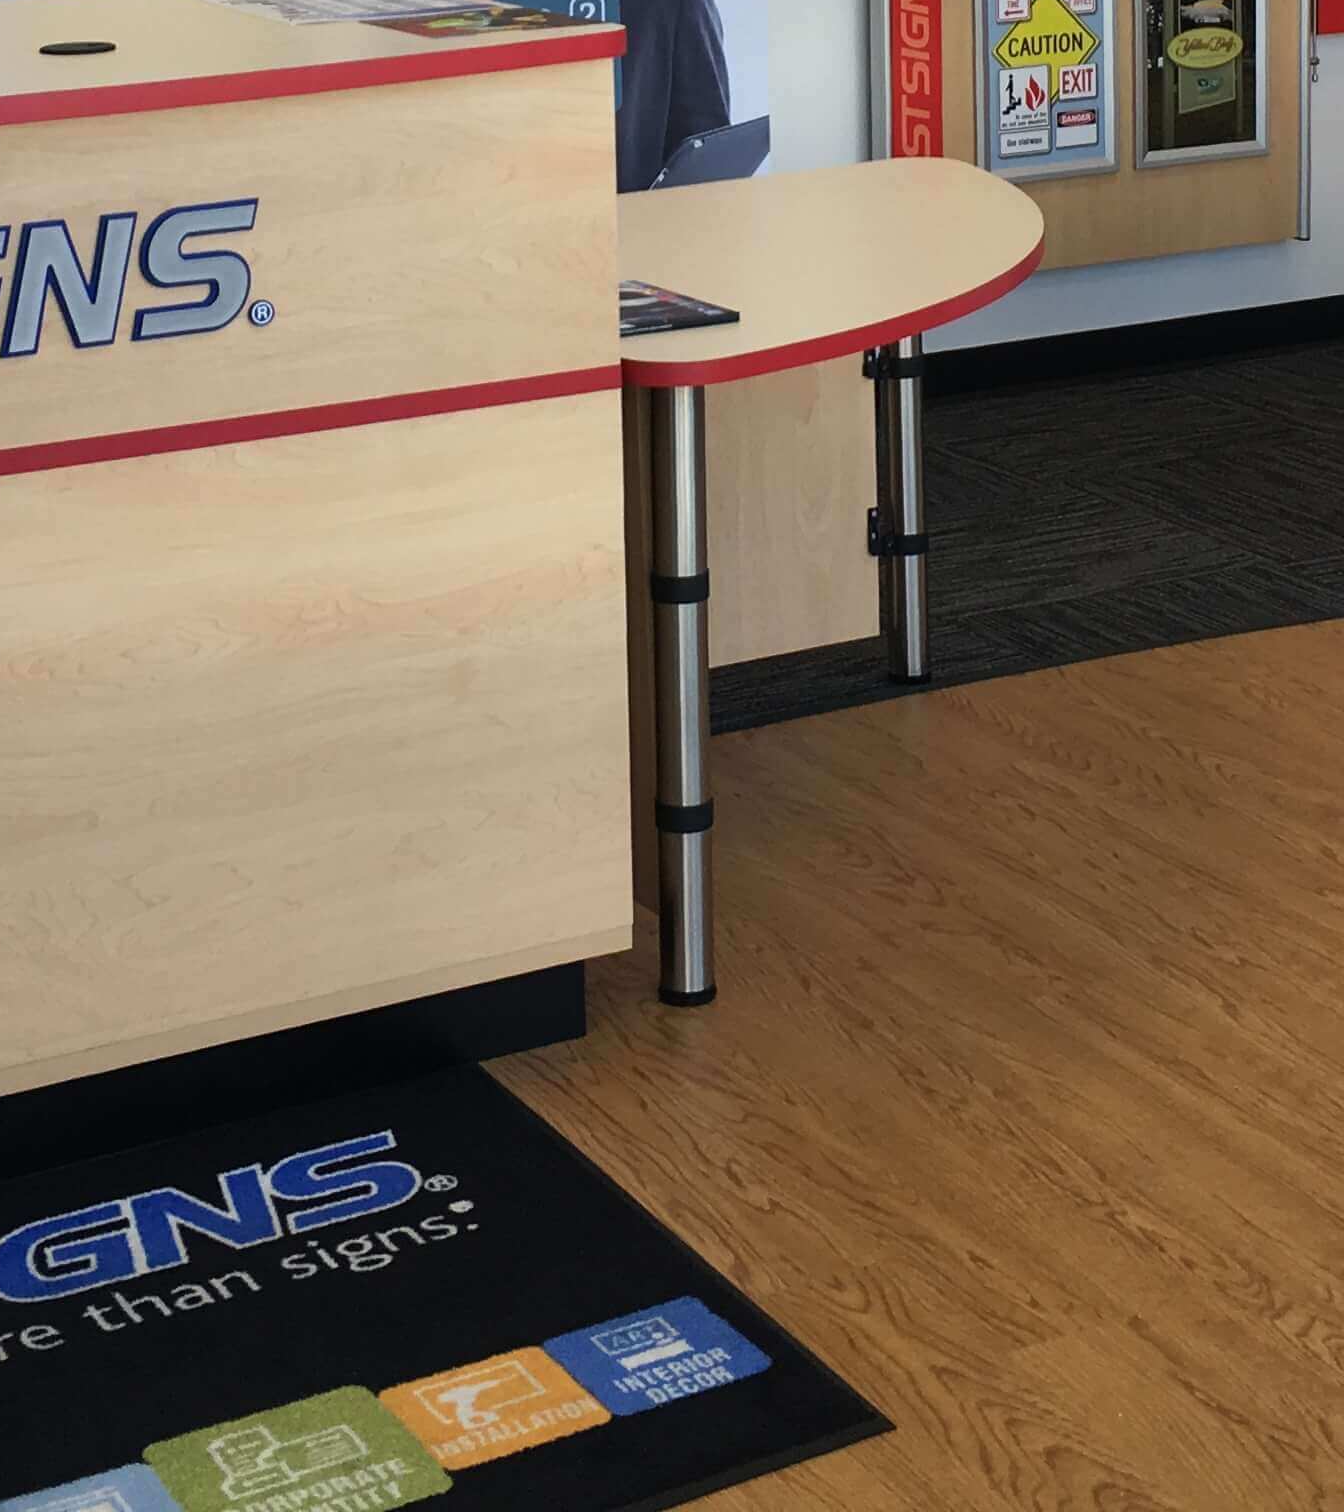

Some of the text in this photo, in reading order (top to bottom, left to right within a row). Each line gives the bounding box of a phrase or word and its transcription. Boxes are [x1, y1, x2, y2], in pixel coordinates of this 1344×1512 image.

[1008, 32, 1083, 57] CAUTION
[1062, 68, 1093, 94] EXIT
[83, 1269, 261, 1332] than
[613, 1347, 732, 1393] INTERIOR
[646, 1366, 735, 1404] DECOR
[430, 1396, 598, 1460] INSTALLATION
